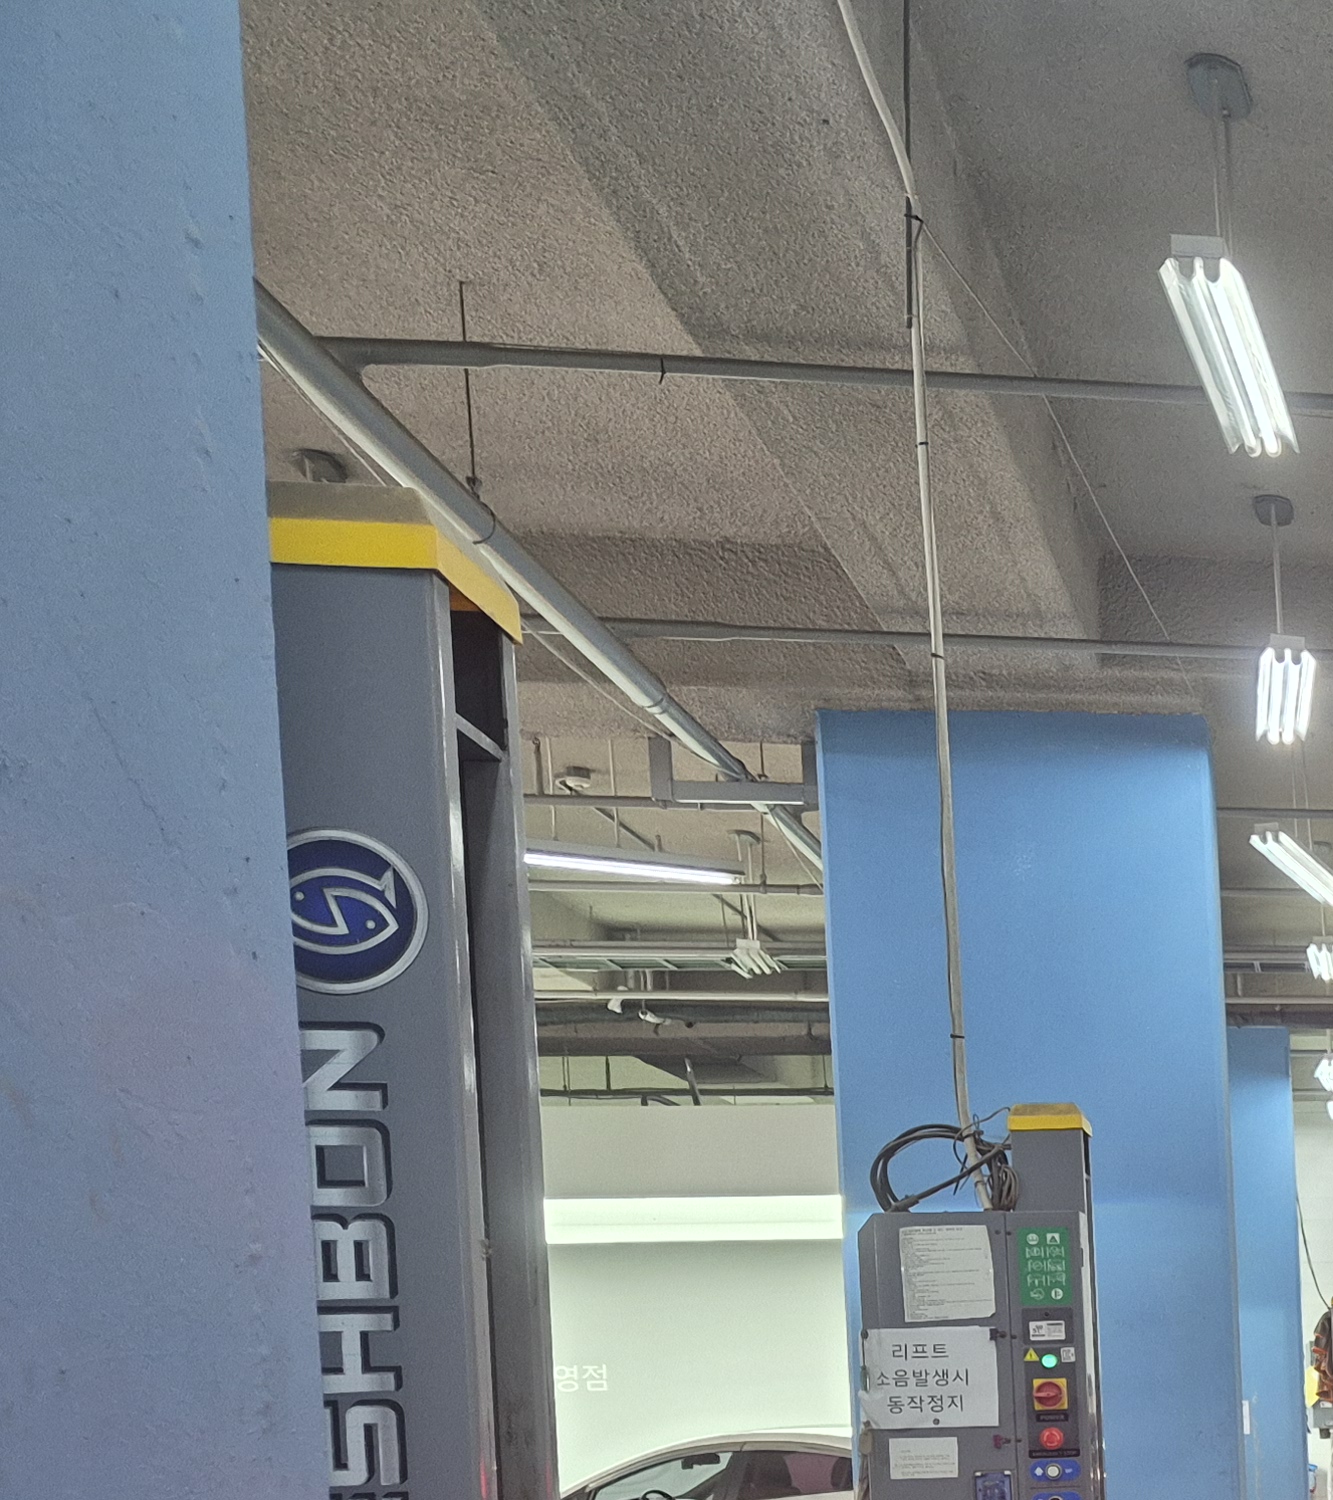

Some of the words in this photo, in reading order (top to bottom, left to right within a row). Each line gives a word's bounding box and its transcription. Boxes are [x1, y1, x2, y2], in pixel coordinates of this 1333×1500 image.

[891, 1343, 949, 1361] 리프트
[877, 1368, 969, 1387] 소음발생시
[887, 1394, 963, 1414] 동작정지
